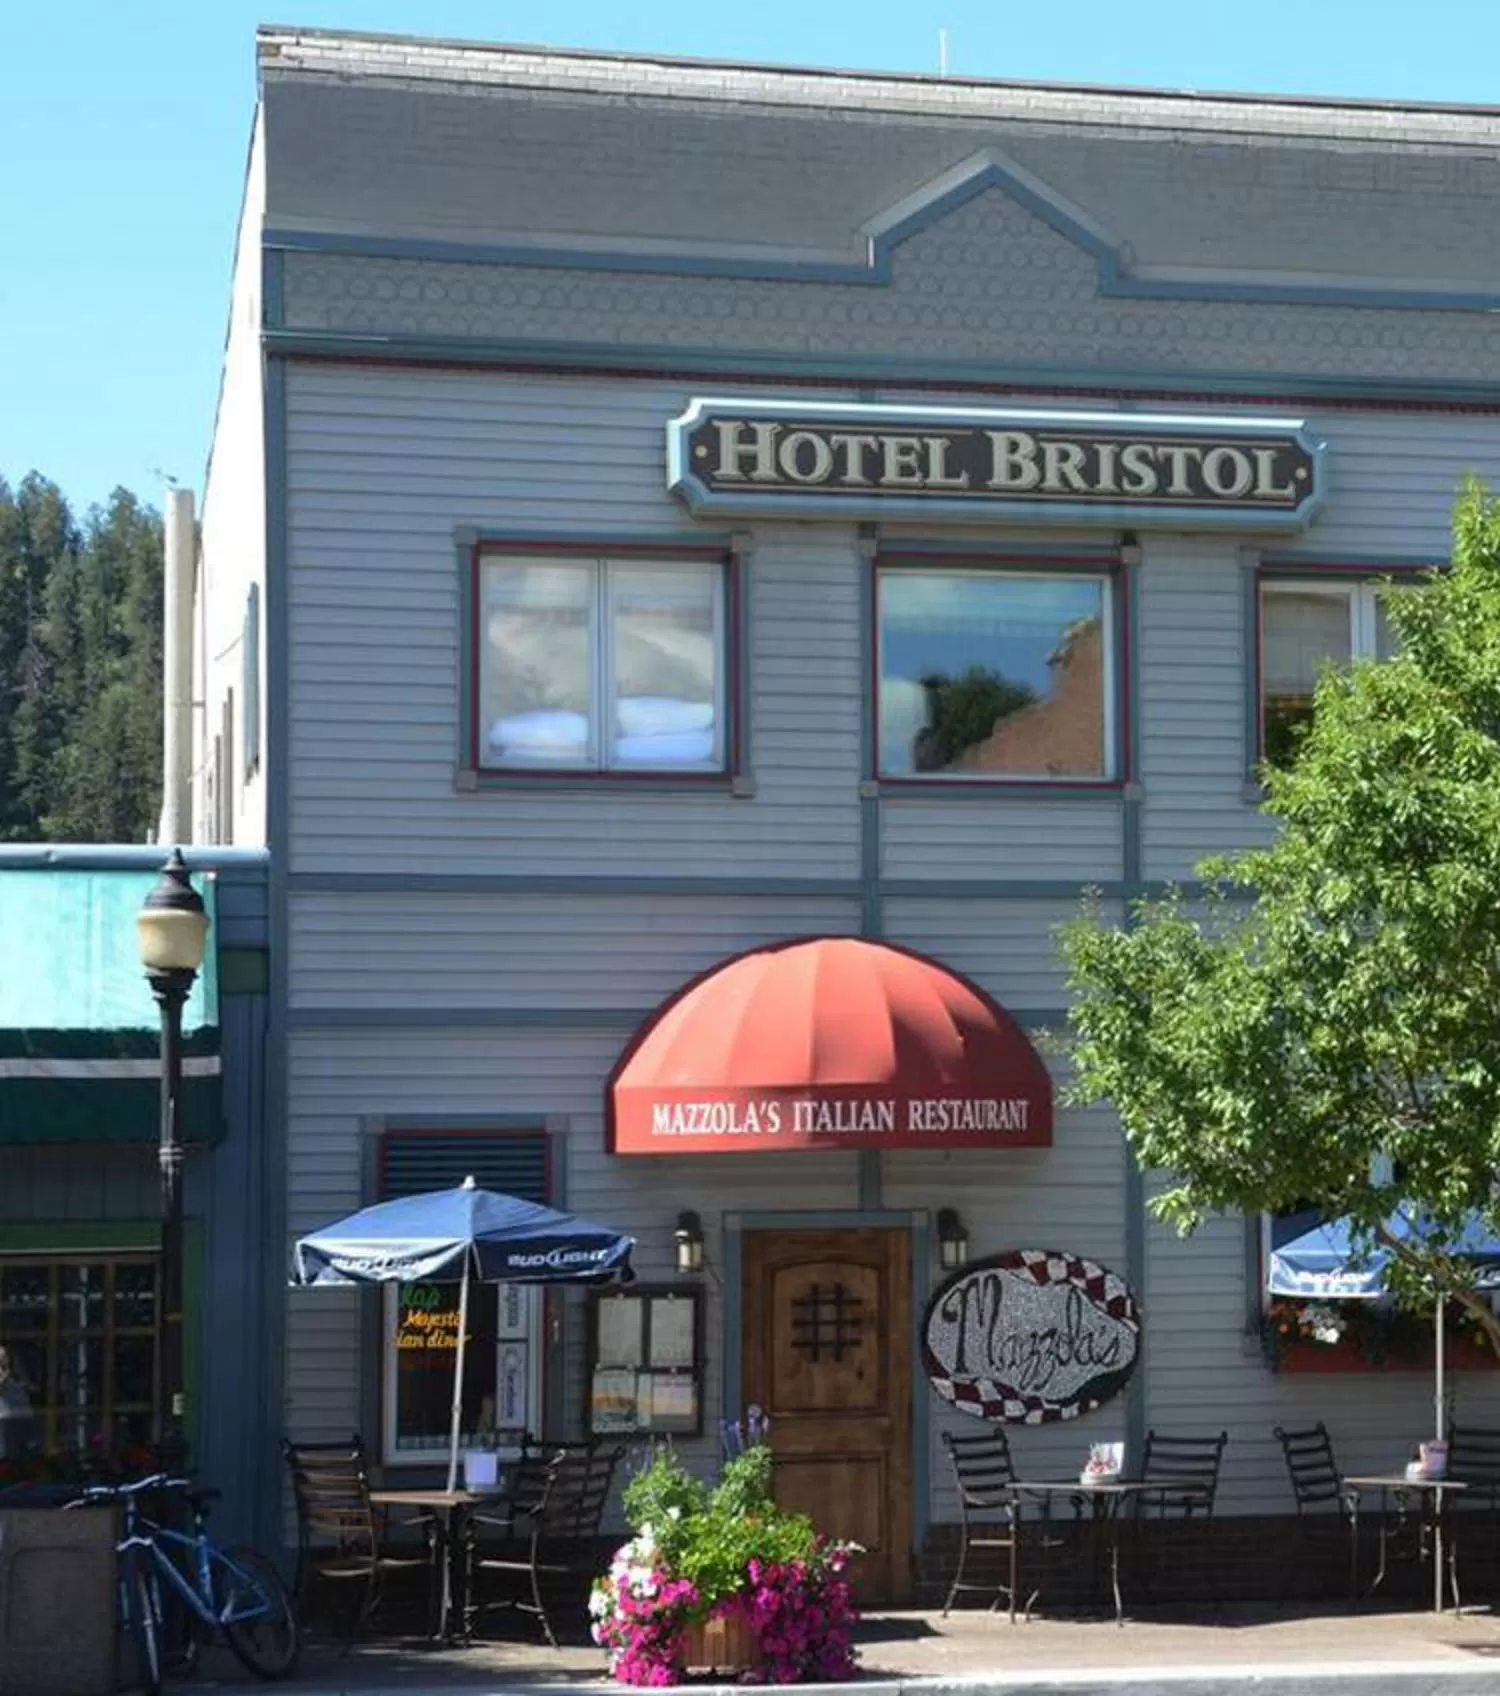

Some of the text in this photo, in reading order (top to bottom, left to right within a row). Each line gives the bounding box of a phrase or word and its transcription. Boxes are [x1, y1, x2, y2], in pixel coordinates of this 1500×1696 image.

[712, 419, 1298, 499] HOTEL BRISTOL
[652, 1099, 1030, 1136] MAZZOLA'S ITALIAN RESTAURANT
[507, 1252, 545, 1267] BUD
[941, 1273, 1121, 1391] Mazzola's
